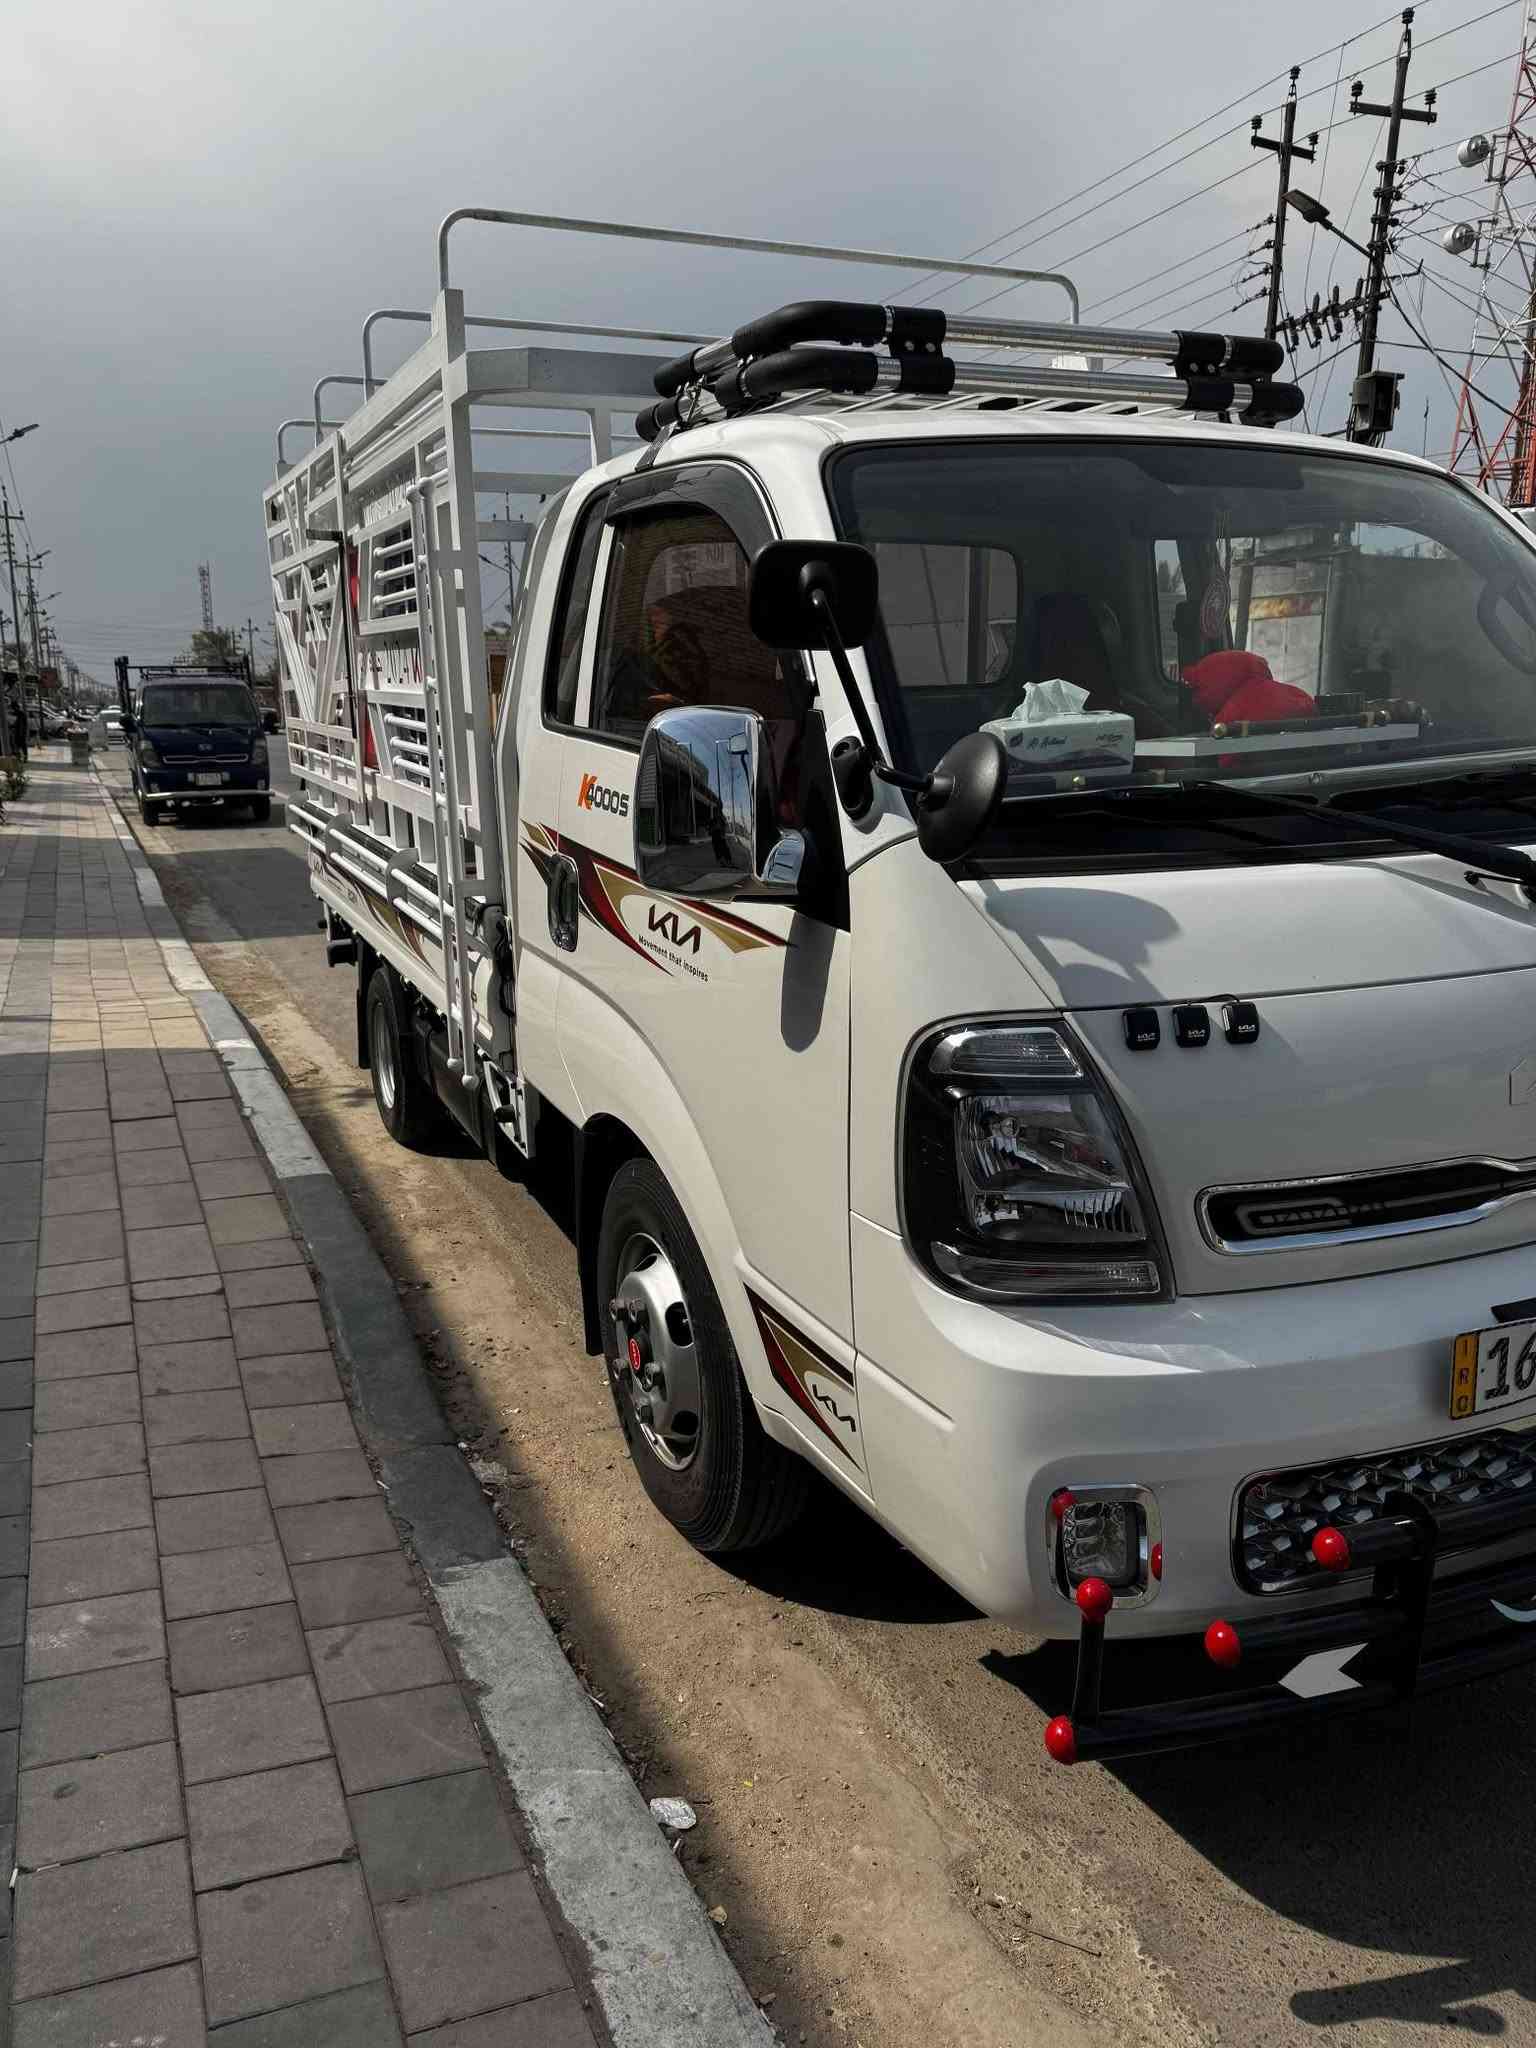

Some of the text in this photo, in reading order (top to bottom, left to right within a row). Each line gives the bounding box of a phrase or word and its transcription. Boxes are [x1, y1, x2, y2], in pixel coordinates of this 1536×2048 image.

[578, 773, 630, 817] K4000S
[648, 904, 702, 954] KIA
[639, 935, 709, 982] Movement that inspires
[811, 1384, 856, 1432] KIA
